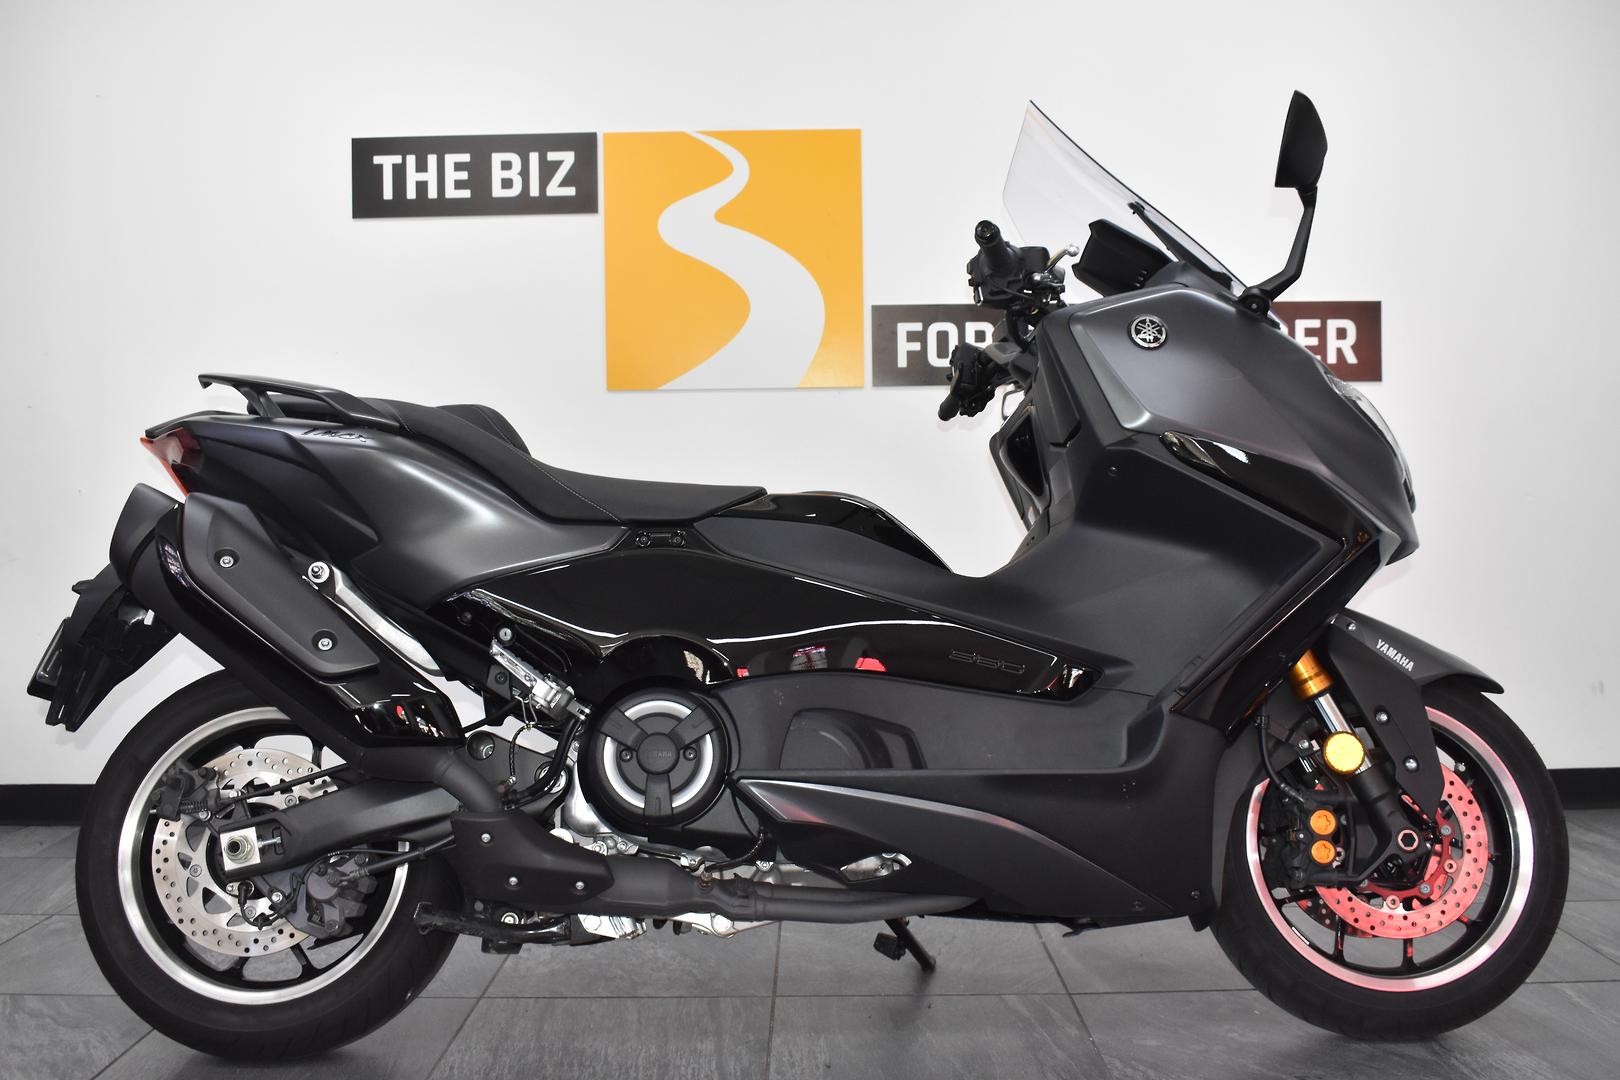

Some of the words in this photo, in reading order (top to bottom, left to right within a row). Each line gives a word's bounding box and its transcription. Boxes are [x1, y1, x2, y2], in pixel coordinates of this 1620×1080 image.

[373, 154, 471, 200] THE
[491, 151, 576, 197] BIZ
[1281, 318, 1358, 364] ER
[1375, 639, 1415, 672] YAMAHA
